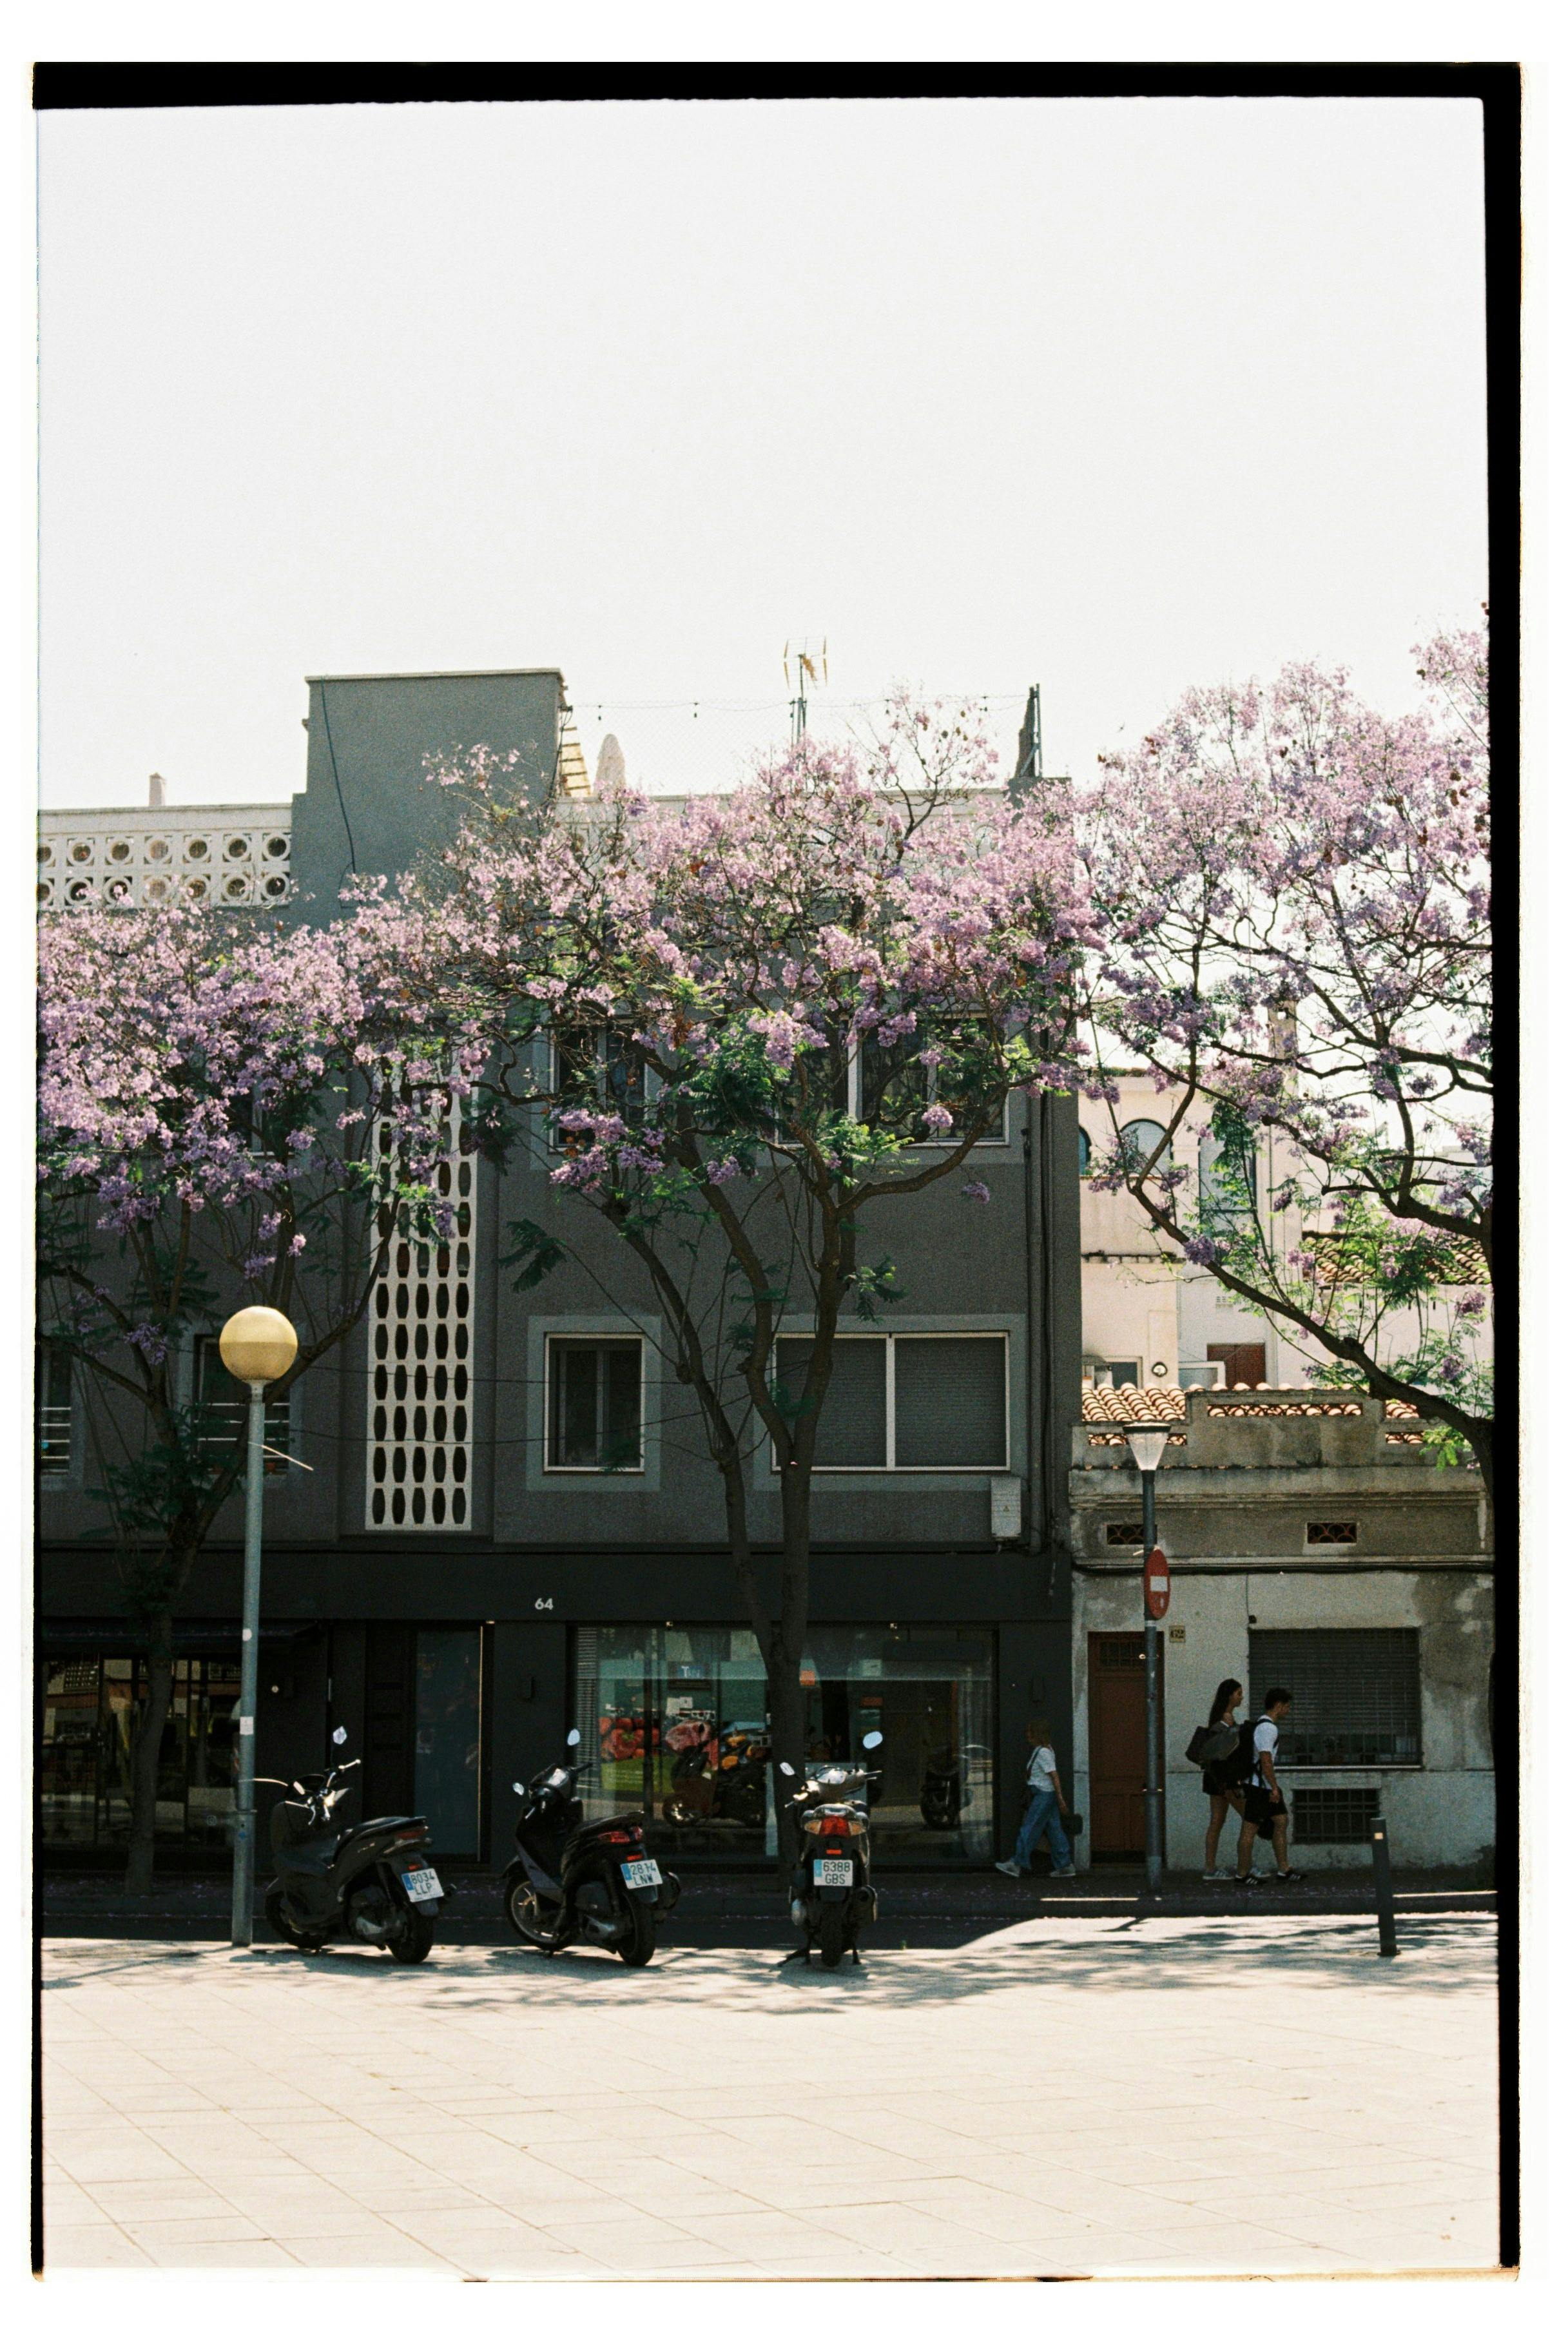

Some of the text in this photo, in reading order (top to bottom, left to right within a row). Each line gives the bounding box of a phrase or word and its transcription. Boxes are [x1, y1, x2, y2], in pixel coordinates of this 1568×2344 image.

[535, 1598, 554, 1610] 64
[630, 1862, 656, 1875] 2814
[823, 1861, 850, 1872] 6388
[411, 1871, 435, 1884] 8034
[825, 1874, 846, 1884] GBS
[414, 1883, 432, 1895] LLP
